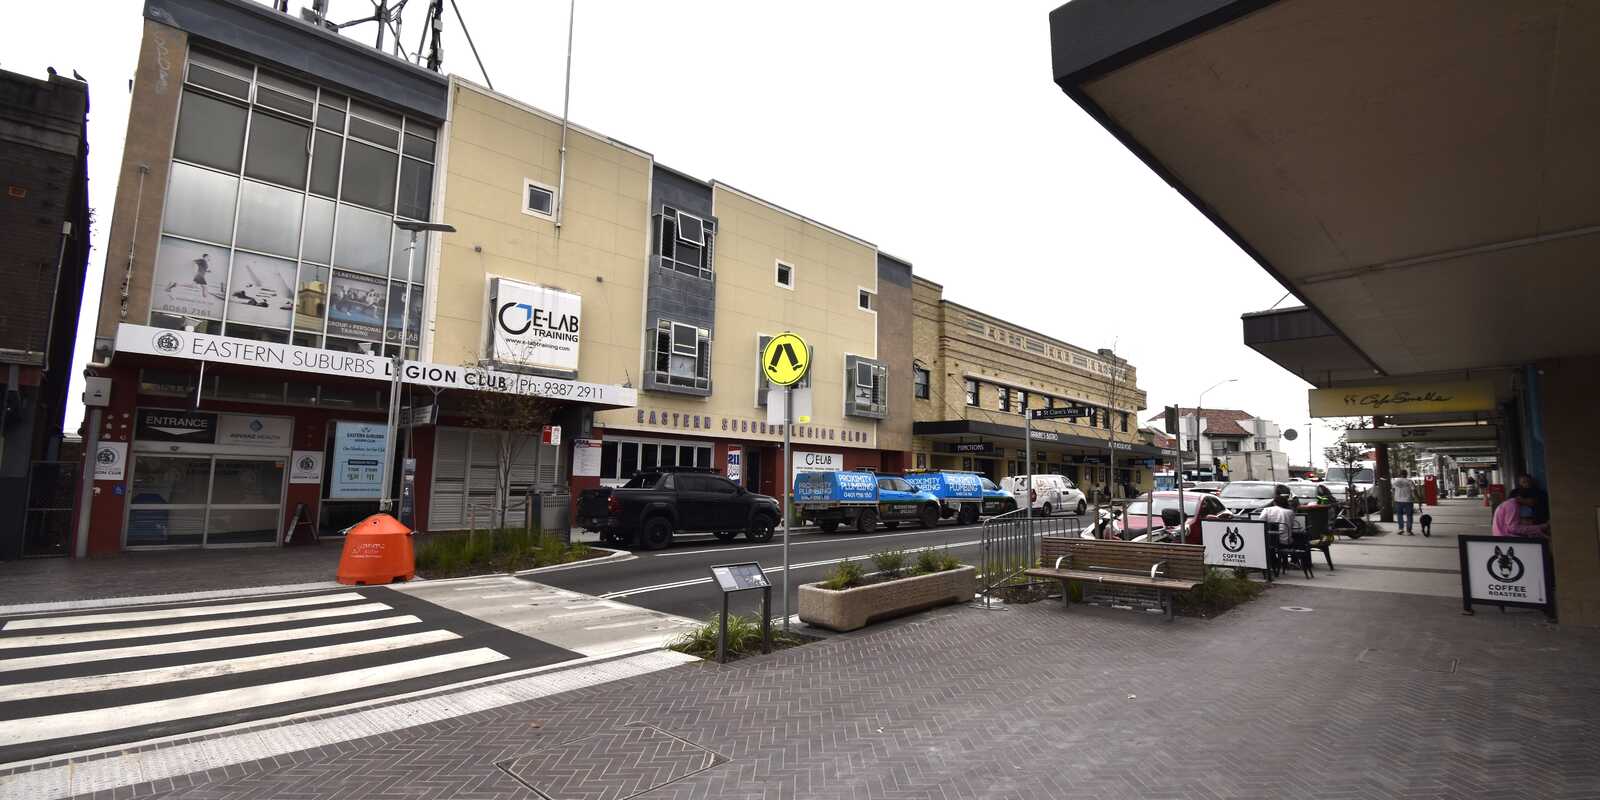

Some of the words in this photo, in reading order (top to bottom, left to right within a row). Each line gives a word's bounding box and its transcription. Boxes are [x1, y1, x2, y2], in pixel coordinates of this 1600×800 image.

[533, 308, 578, 332] E-LAB
[533, 328, 578, 342] TRAINING
[192, 338, 284, 364] EASTERN
[292, 350, 375, 374] SUBURBS
[385, 362, 456, 383] LGION
[464, 372, 506, 388] CLUB
[544, 382, 574, 396] 9387
[577, 386, 603, 399] 2911
[145, 416, 208, 428] ENTRANCE
[637, 409, 711, 429] EASTERN
[792, 425, 834, 440] LEGION
[841, 430, 867, 443] CLUB
[815, 454, 832, 465] E-LAB
[838, 475, 872, 483] PROXIMITY
[841, 482, 874, 491] PLUMBING
[950, 483, 978, 492] PLUMBING
[1488, 584, 1527, 592] COFFEE
